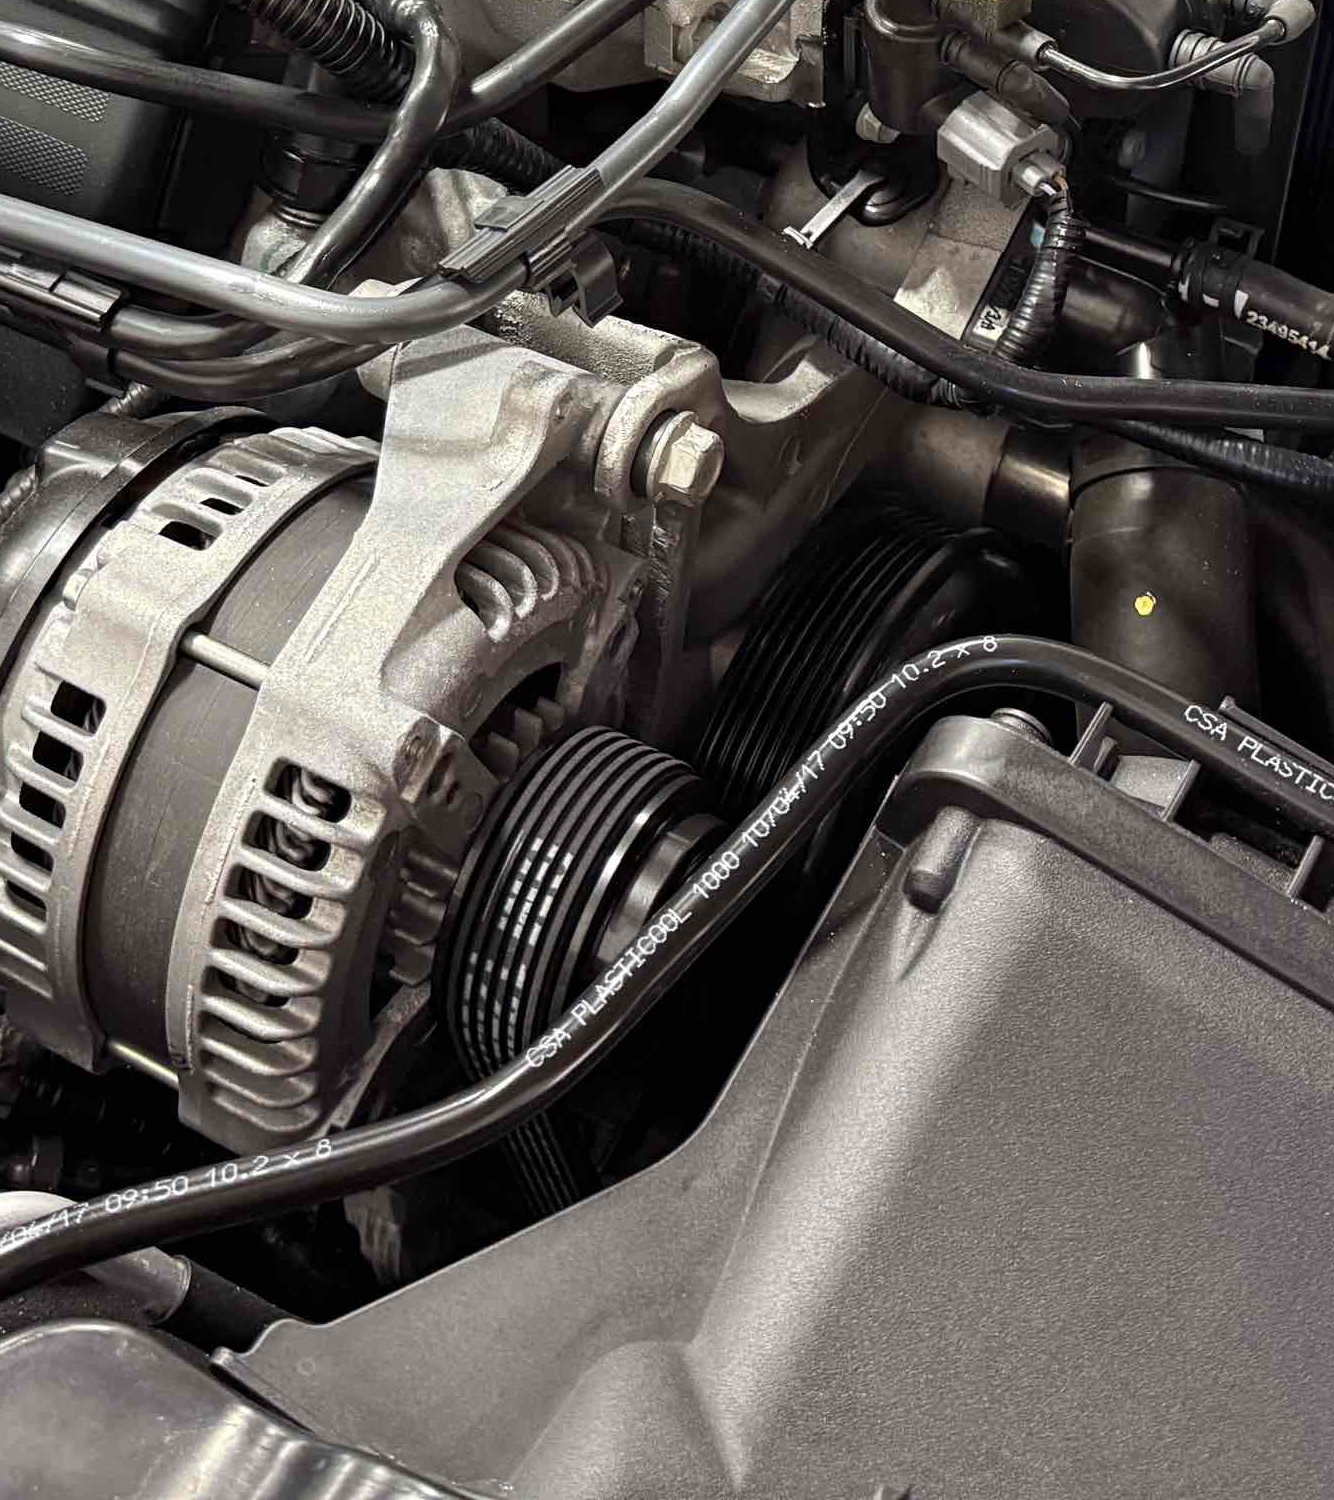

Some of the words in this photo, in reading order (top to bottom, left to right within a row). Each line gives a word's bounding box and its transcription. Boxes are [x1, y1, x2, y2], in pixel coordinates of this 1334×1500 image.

[1184, 705, 1227, 740] CSA
[526, 1028, 570, 1067] CSA
[571, 908, 692, 1025] PLASTICOOL
[693, 851, 739, 898] 1000
[740, 750, 824, 848] 10/04/17
[828, 689, 886, 749] 09:50
[891, 650, 946, 688] 10.2
[982, 635, 998, 652] 8
[104, 1176, 189, 1213] 09:50
[205, 1155, 268, 1188] 10.2
[282, 1153, 301, 1168] x
[315, 1138, 332, 1158] 8
